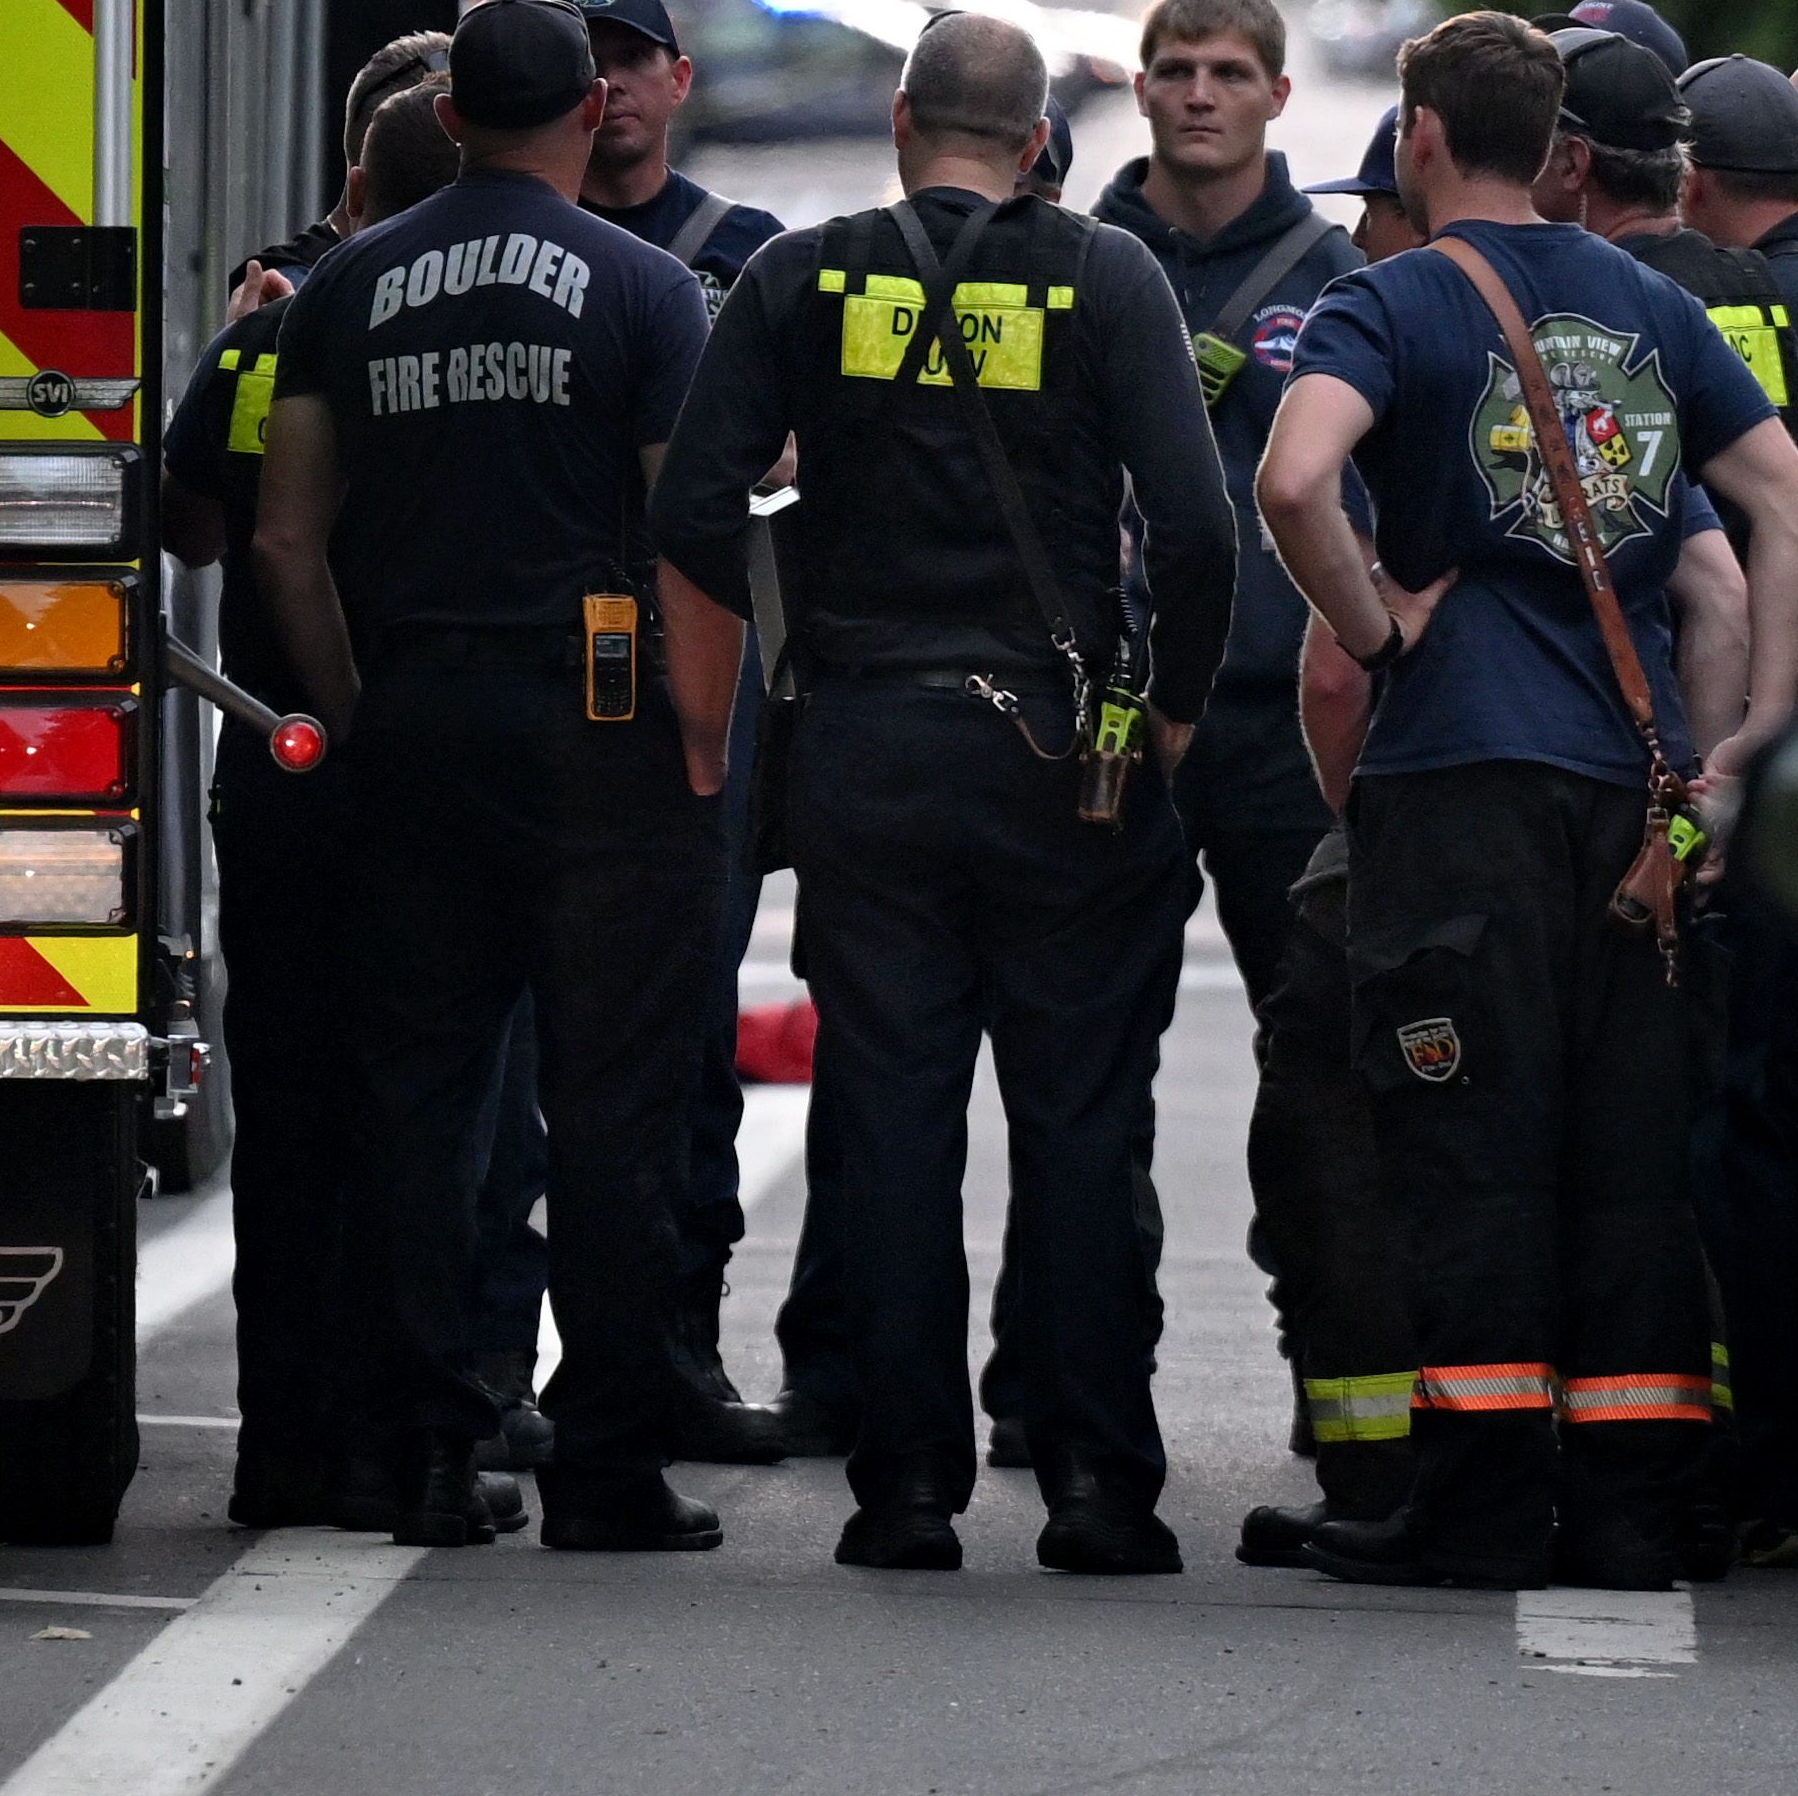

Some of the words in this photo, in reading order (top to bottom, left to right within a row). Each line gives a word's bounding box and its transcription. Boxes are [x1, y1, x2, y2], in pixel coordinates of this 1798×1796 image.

[367, 232, 592, 331] BOULDER
[1533, 335, 1582, 353] UNTAIN
[1586, 335, 1622, 356] VIEW
[32, 381, 70, 404] SVI
[367, 351, 441, 417] FIRE
[446, 340, 573, 406] RESCUE
[1624, 411, 1672, 428] STATION
[1636, 430, 1664, 478] 7
